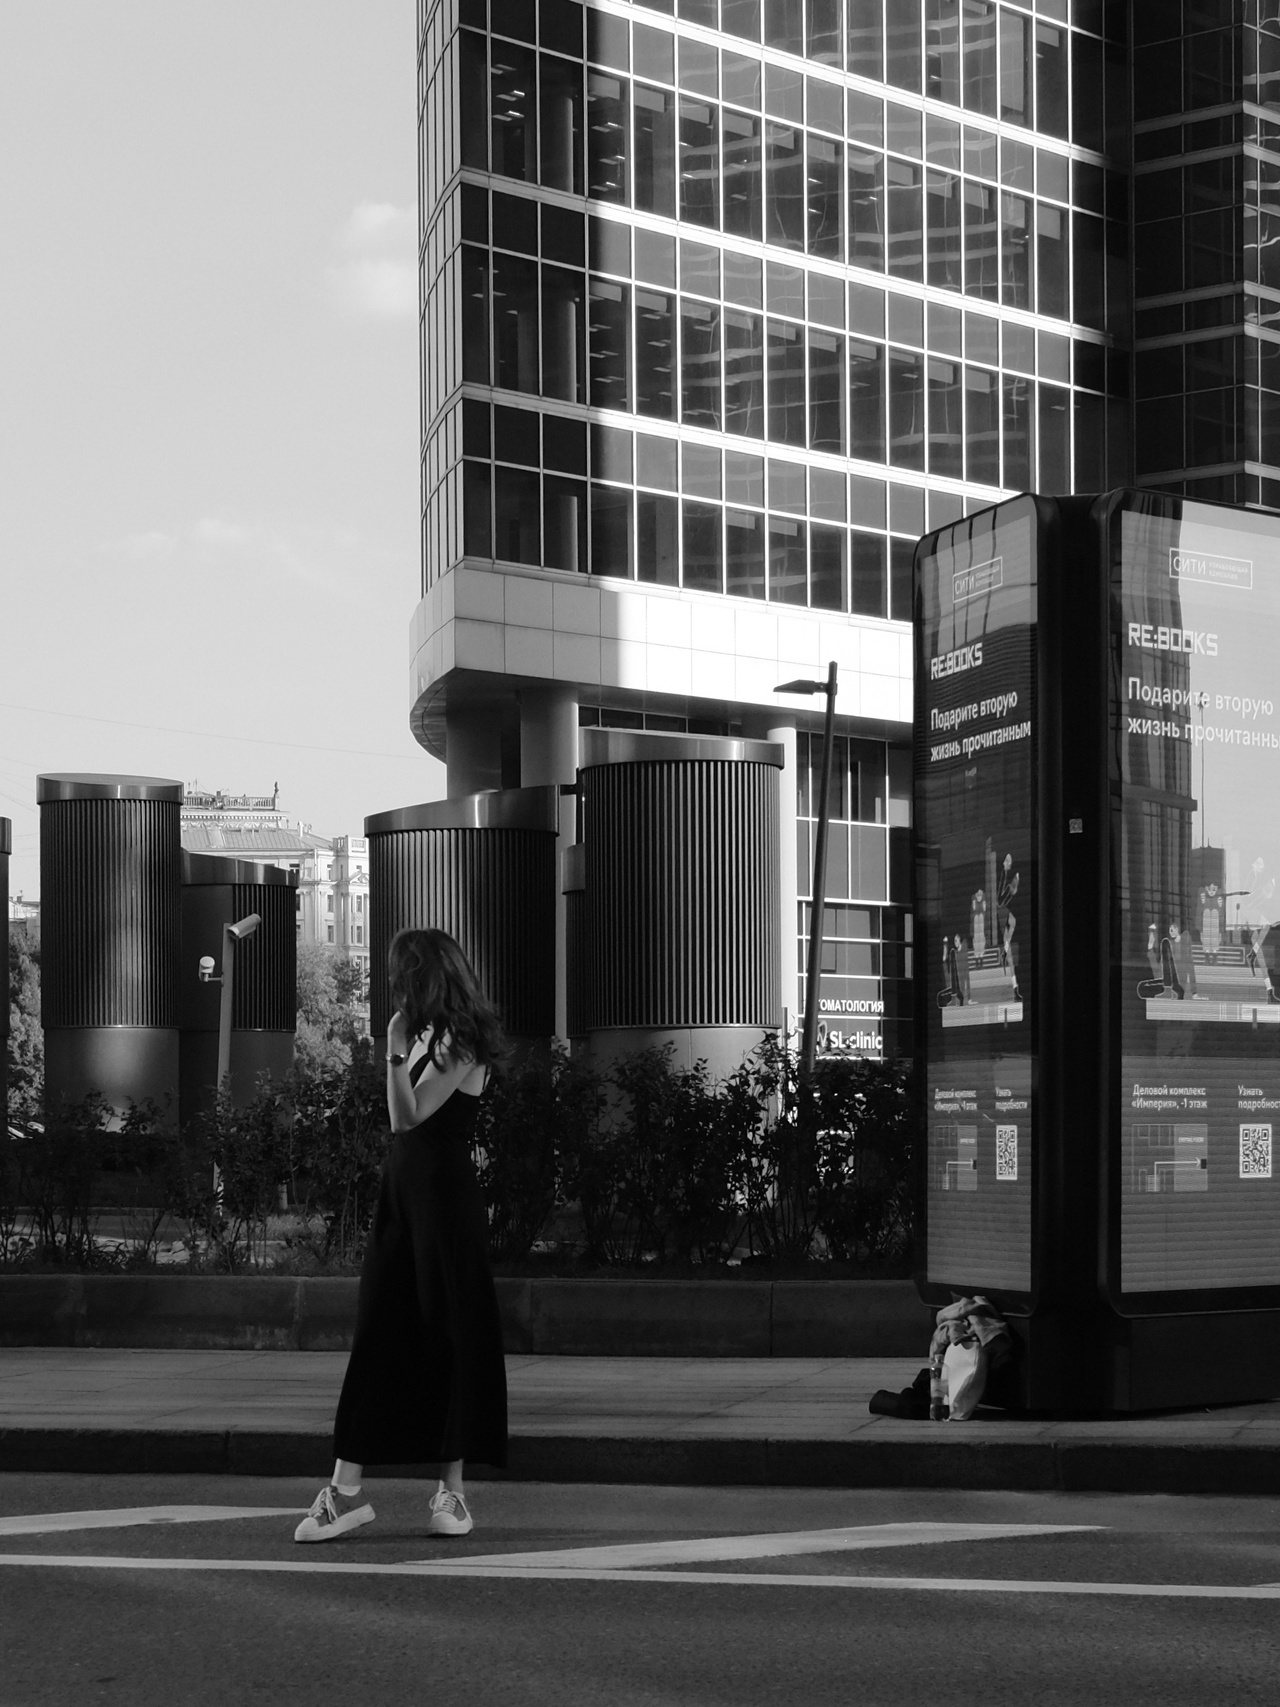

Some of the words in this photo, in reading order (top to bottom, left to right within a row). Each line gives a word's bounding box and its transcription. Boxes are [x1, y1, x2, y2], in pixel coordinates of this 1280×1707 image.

[1173, 556, 1206, 575] СИТИ
[955, 575, 975, 595] СИТИ
[1128, 622, 1218, 656] RE:BOOKS
[931, 642, 983, 680] RE:BOOKS
[1128, 677, 1210, 708] Подарите
[1215, 692, 1274, 720] вторую
[931, 704, 978, 731] Подарите
[980, 691, 1018, 720] вторую
[1128, 717, 1180, 738] жизнь
[931, 742, 961, 762] жизнь
[963, 720, 1031, 758] прочитанным
[819, 998, 884, 1013] ОМАТОЛОГИЯ
[1132, 1084, 1168, 1097] Деловой
[1169, 1086, 1206, 1096] комплекс
[1238, 1084, 1263, 1096] Узнать
[1188, 1100, 1208, 1109] этаж
